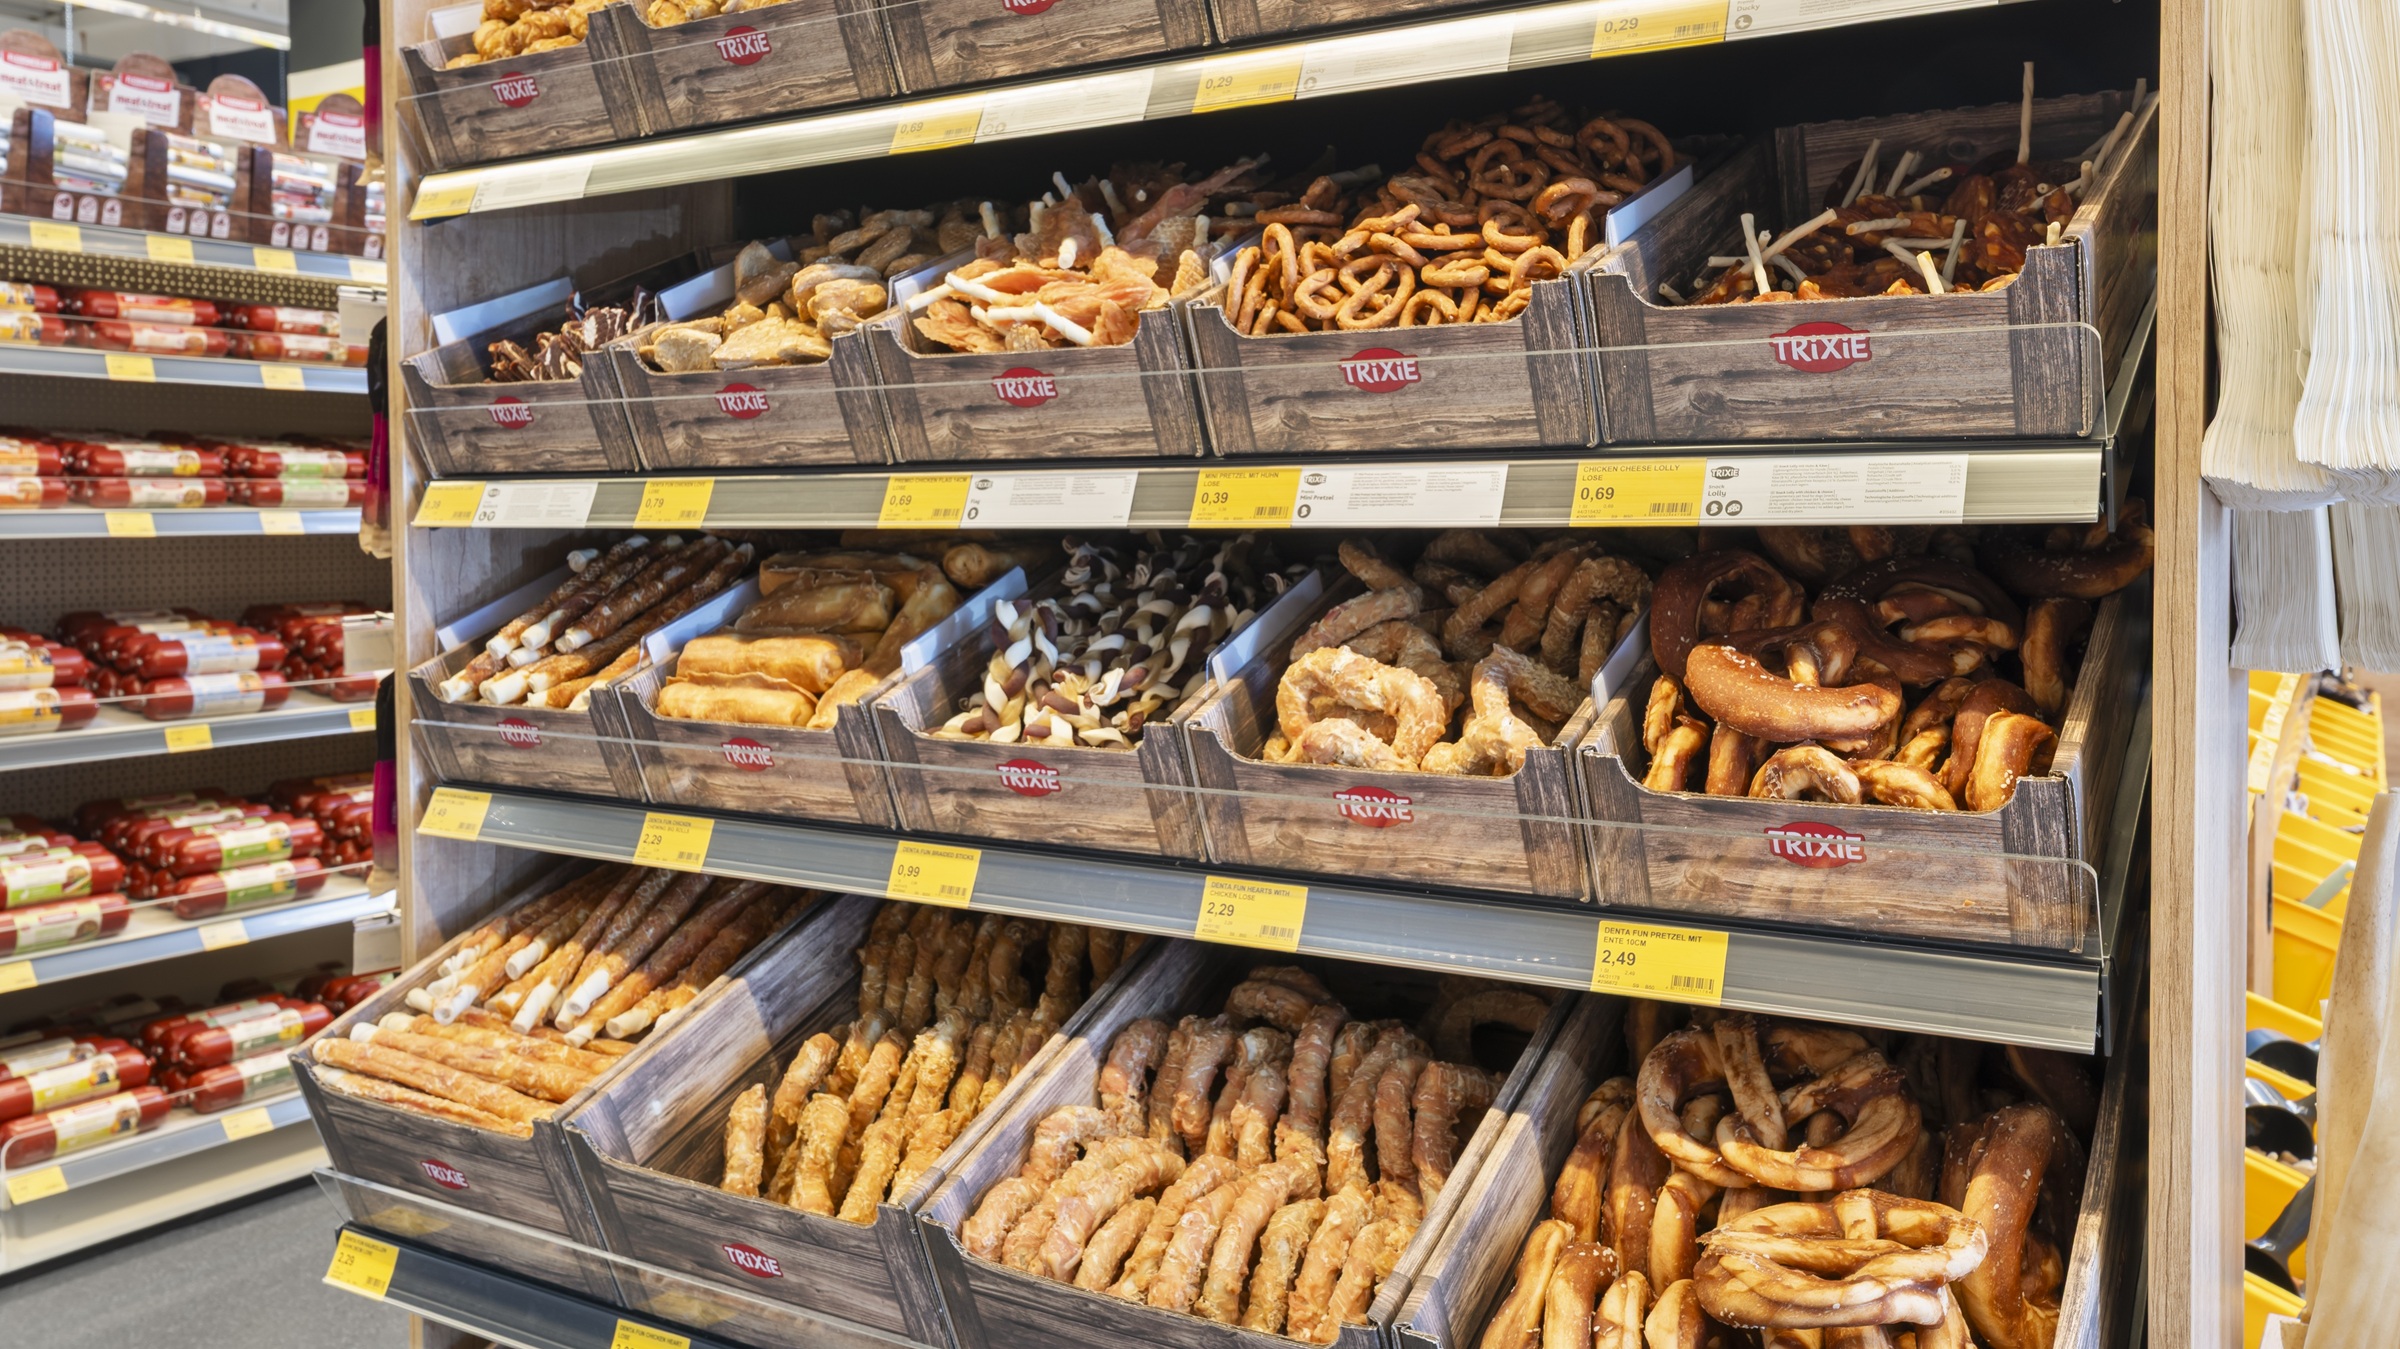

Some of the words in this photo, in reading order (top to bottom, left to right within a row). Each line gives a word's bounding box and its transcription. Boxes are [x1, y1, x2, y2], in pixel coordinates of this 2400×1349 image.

[1737, 4, 1760, 12] Ducky
[1604, 17, 1639, 34] 0,29
[1205, 76, 1233, 90] 0,29
[900, 121, 924, 134] 0,69
[1583, 465, 1618, 473] CHICKEN
[1201, 492, 1229, 505] 0,39
[1580, 487, 1615, 502] 0,69
[1708, 490, 1727, 498] Lolly
[645, 498, 664, 509] 0,79
[889, 495, 912, 507] 0,69
[643, 833, 662, 846] 2,29
[902, 846, 919, 854] DENTA
[920, 848, 931, 856] FUN
[932, 850, 954, 858] BRAIDED
[955, 852, 974, 861] STICKS
[897, 864, 920, 878] 0,99
[1210, 890, 1237, 899] CHICKEN
[1238, 893, 1255, 901] LOSE
[1211, 881, 1232, 890] DENTA
[1233, 884, 1246, 892] FUN
[1247, 886, 1273, 895] HEARTS
[1274, 889, 1290, 897] WITH
[1207, 901, 1235, 917] 2,29
[1603, 936, 1623, 944] ENTE
[1626, 938, 1646, 947] 10CM
[1604, 927, 1630, 936] DENTA
[1633, 929, 1648, 938] FUN
[1650, 931, 1686, 941] PRETZEL
[1688, 935, 1702, 943] MIT
[1602, 949, 1636, 967] 2,49
[646, 1332, 666, 1342] CHICKEN
[666, 1338, 682, 1347] HEART
